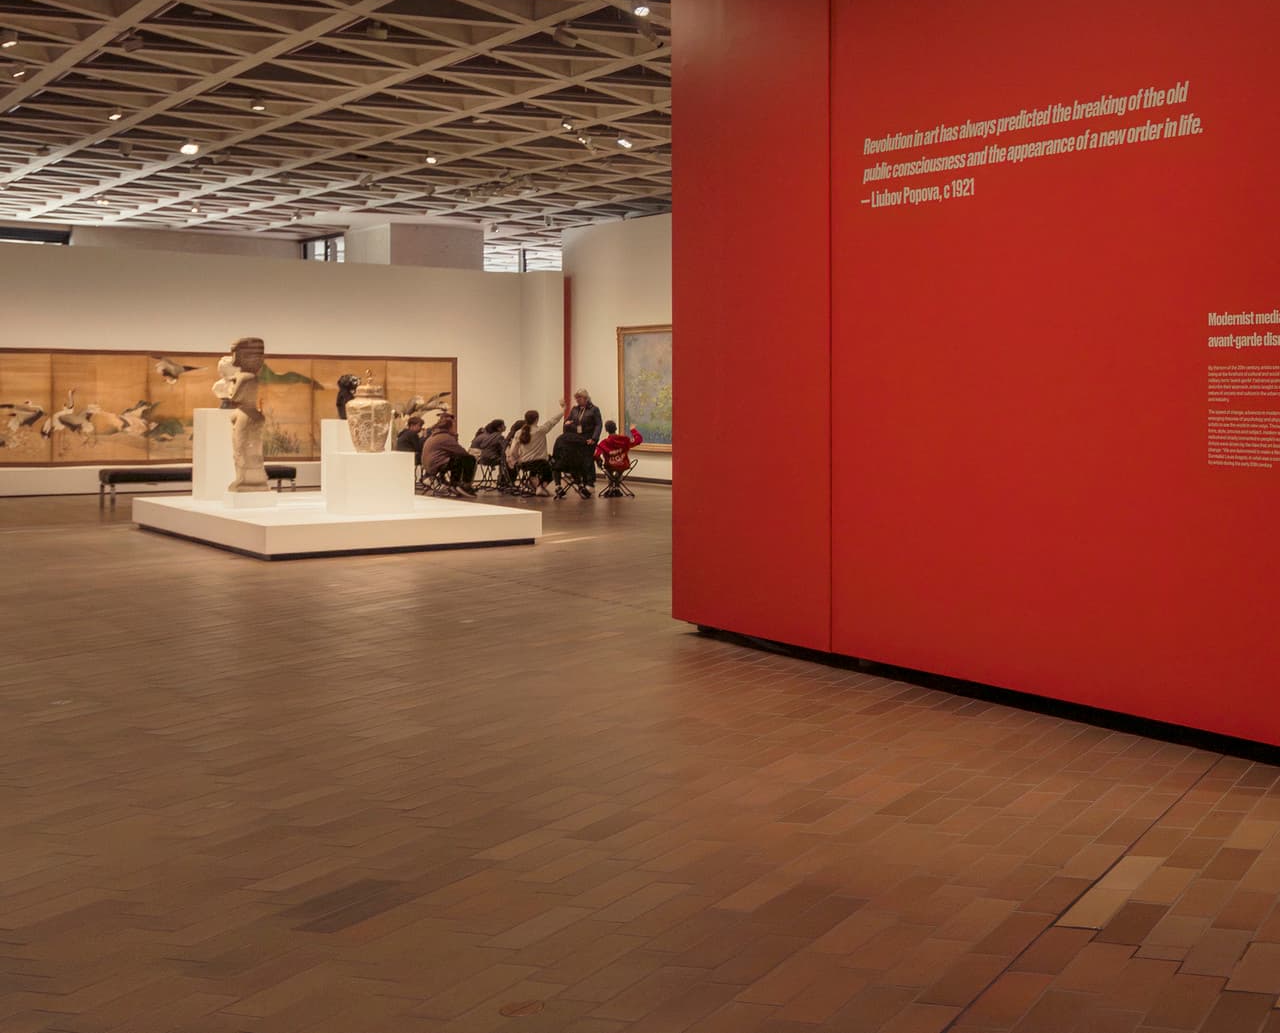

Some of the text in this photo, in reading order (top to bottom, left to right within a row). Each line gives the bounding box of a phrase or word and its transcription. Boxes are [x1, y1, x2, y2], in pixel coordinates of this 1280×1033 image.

[864, 80, 1190, 155] Revolution in art has always predicted the breaking of the old
[863, 113, 1204, 184] public consciousness and the appearance of a new order in life.
[871, 189, 903, 208] Liubov
[903, 186, 943, 206] Popova,
[943, 184, 950, 199] c
[951, 177, 975, 198] 1921
[1208, 311, 1255, 326] Modernist
[1208, 332, 1263, 349] avant-garde
